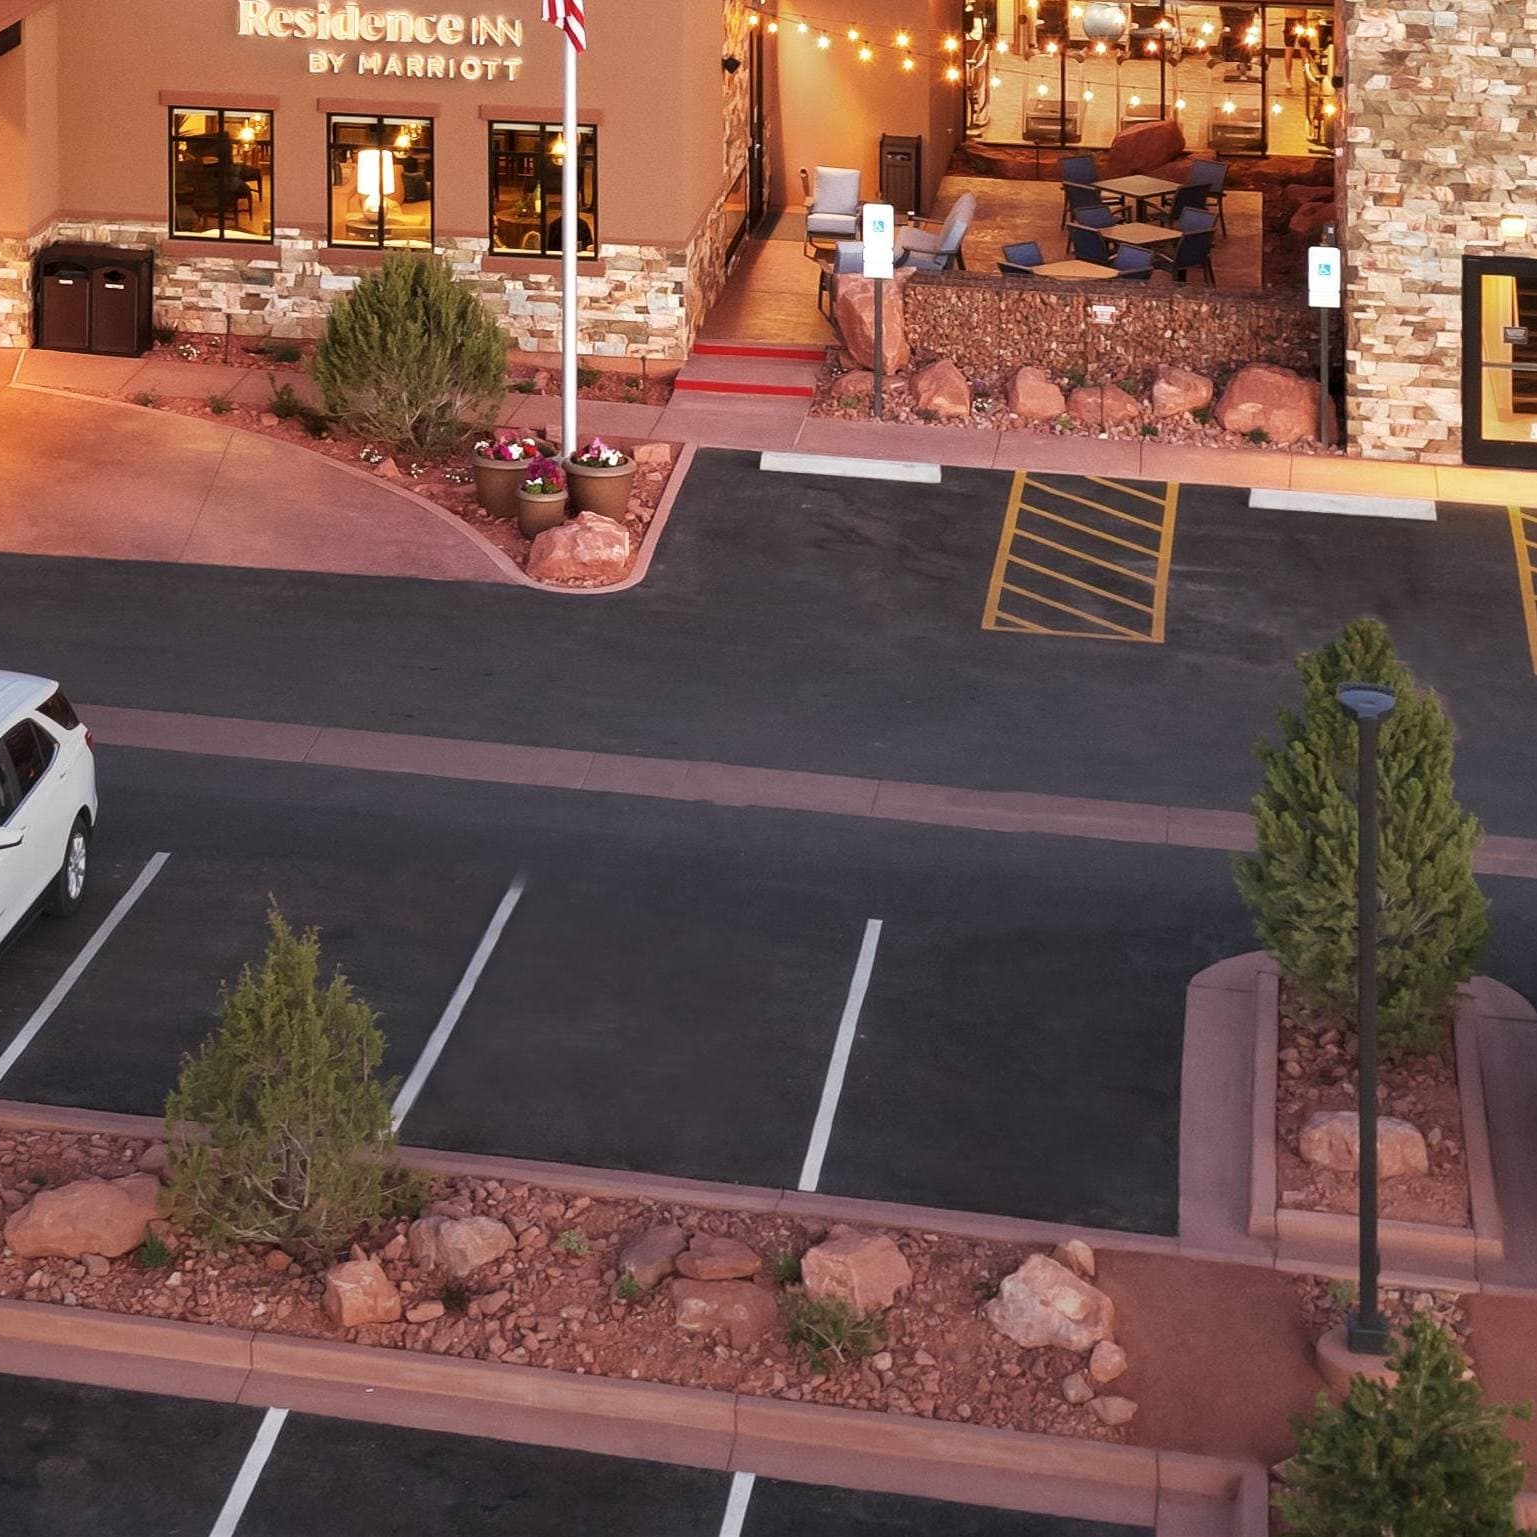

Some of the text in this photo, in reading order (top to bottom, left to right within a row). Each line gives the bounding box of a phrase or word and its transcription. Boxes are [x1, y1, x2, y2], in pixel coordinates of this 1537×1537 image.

[471, 16, 523, 48] INN
[308, 51, 523, 82] BY MARRIOTT
